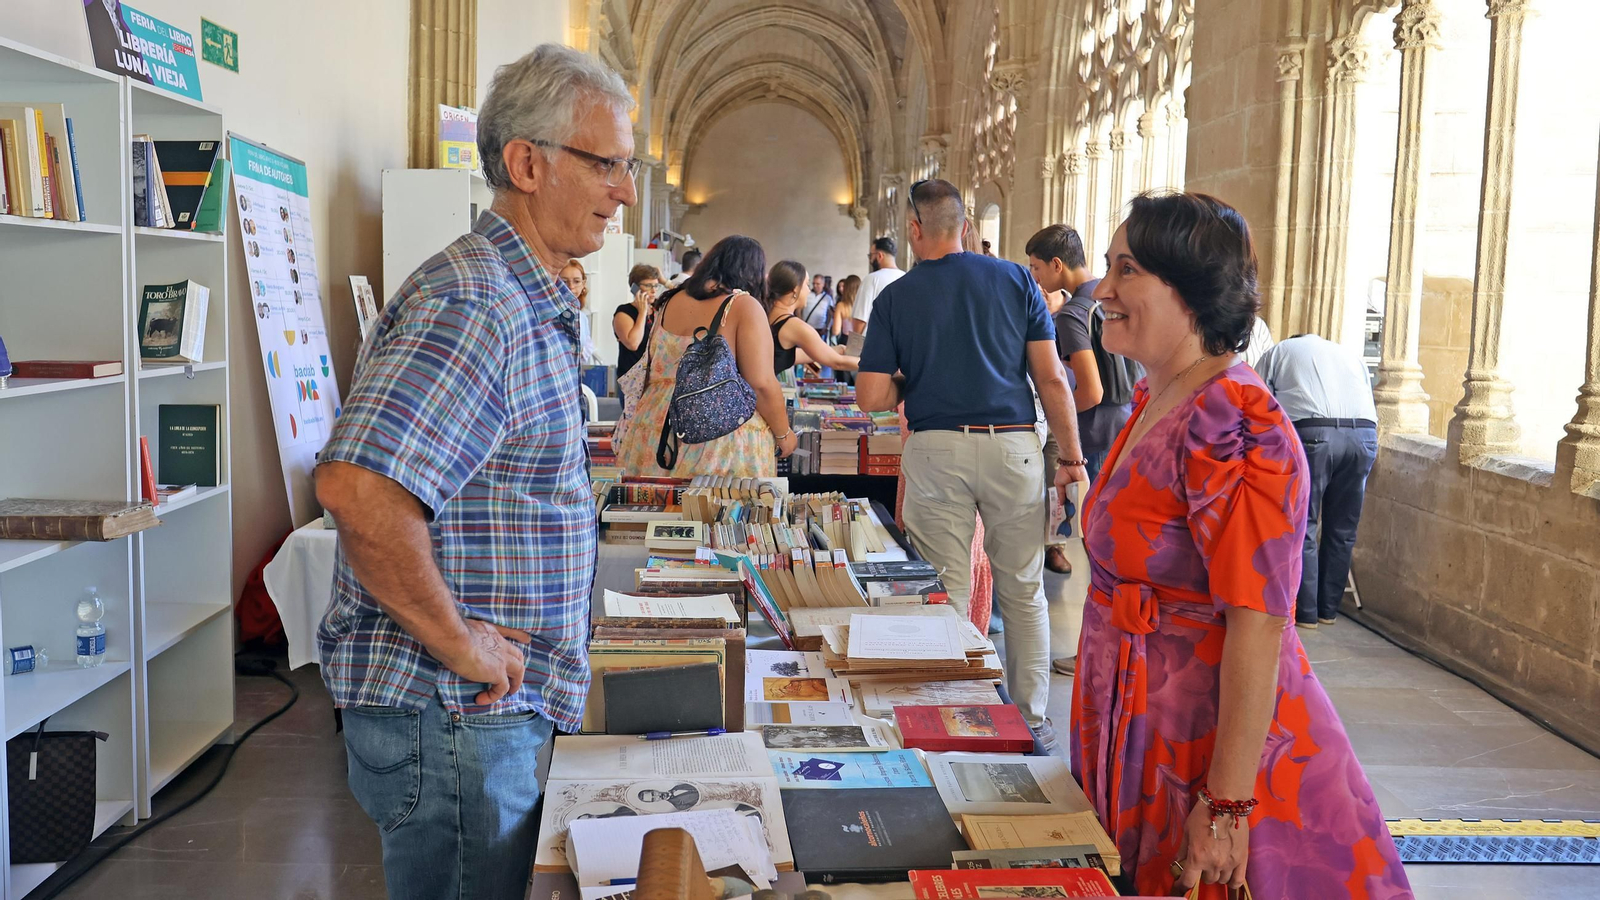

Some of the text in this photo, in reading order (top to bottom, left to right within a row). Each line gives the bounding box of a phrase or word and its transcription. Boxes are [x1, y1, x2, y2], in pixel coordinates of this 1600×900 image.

[130, 10, 192, 46] FERIA DEL LIBRO
[119, 29, 178, 67] LIBRERÍA
[114, 48, 188, 91] LUNA VIEJA
[443, 110, 470, 122] ORIGEN
[248, 160, 293, 185] FIRMA DE AUTORES
[145, 291, 168, 300] TORO
[168, 287, 187, 299] BRAVO
